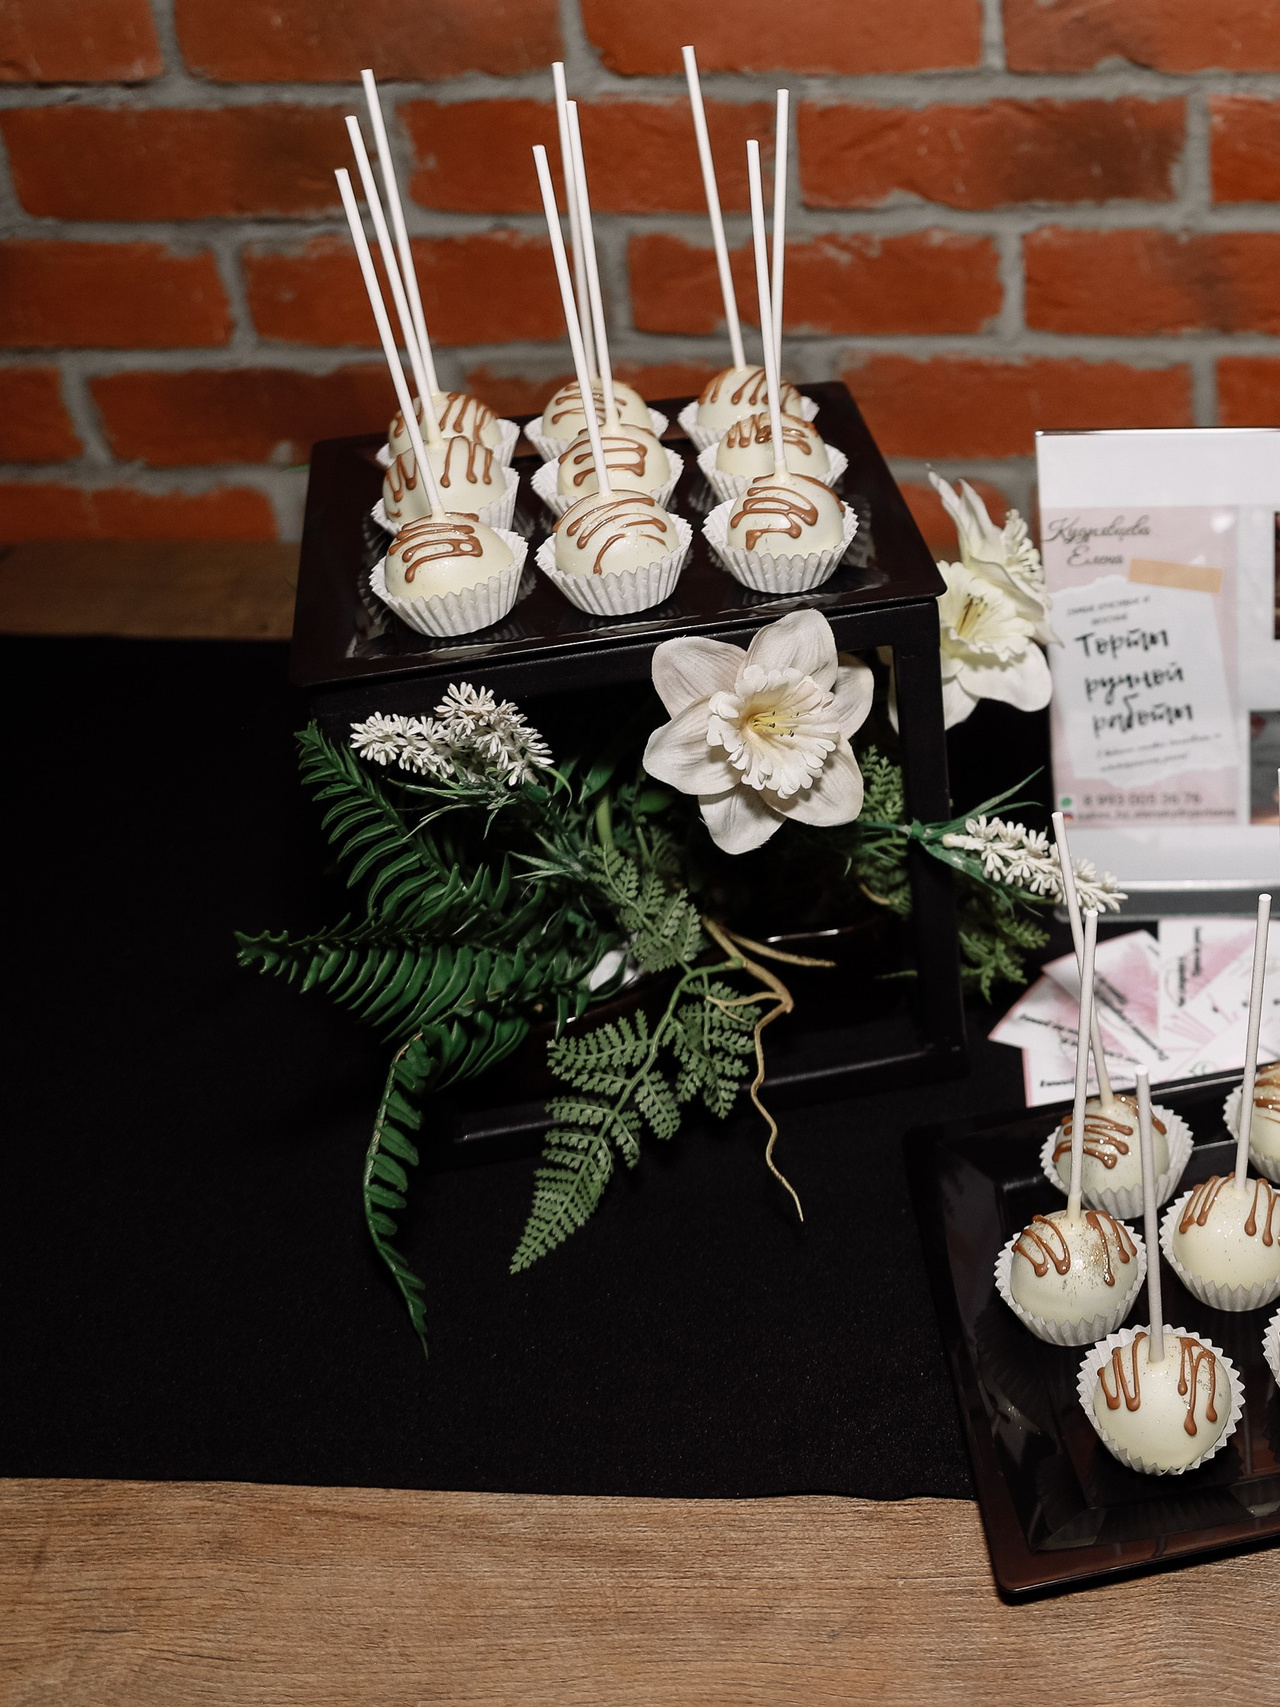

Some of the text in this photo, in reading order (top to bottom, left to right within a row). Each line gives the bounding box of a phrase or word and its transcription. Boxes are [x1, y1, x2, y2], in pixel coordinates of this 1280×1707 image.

[1075, 628, 1169, 659] Торты
[1084, 661, 1184, 706] ручной
[1092, 693, 1193, 739] работы
